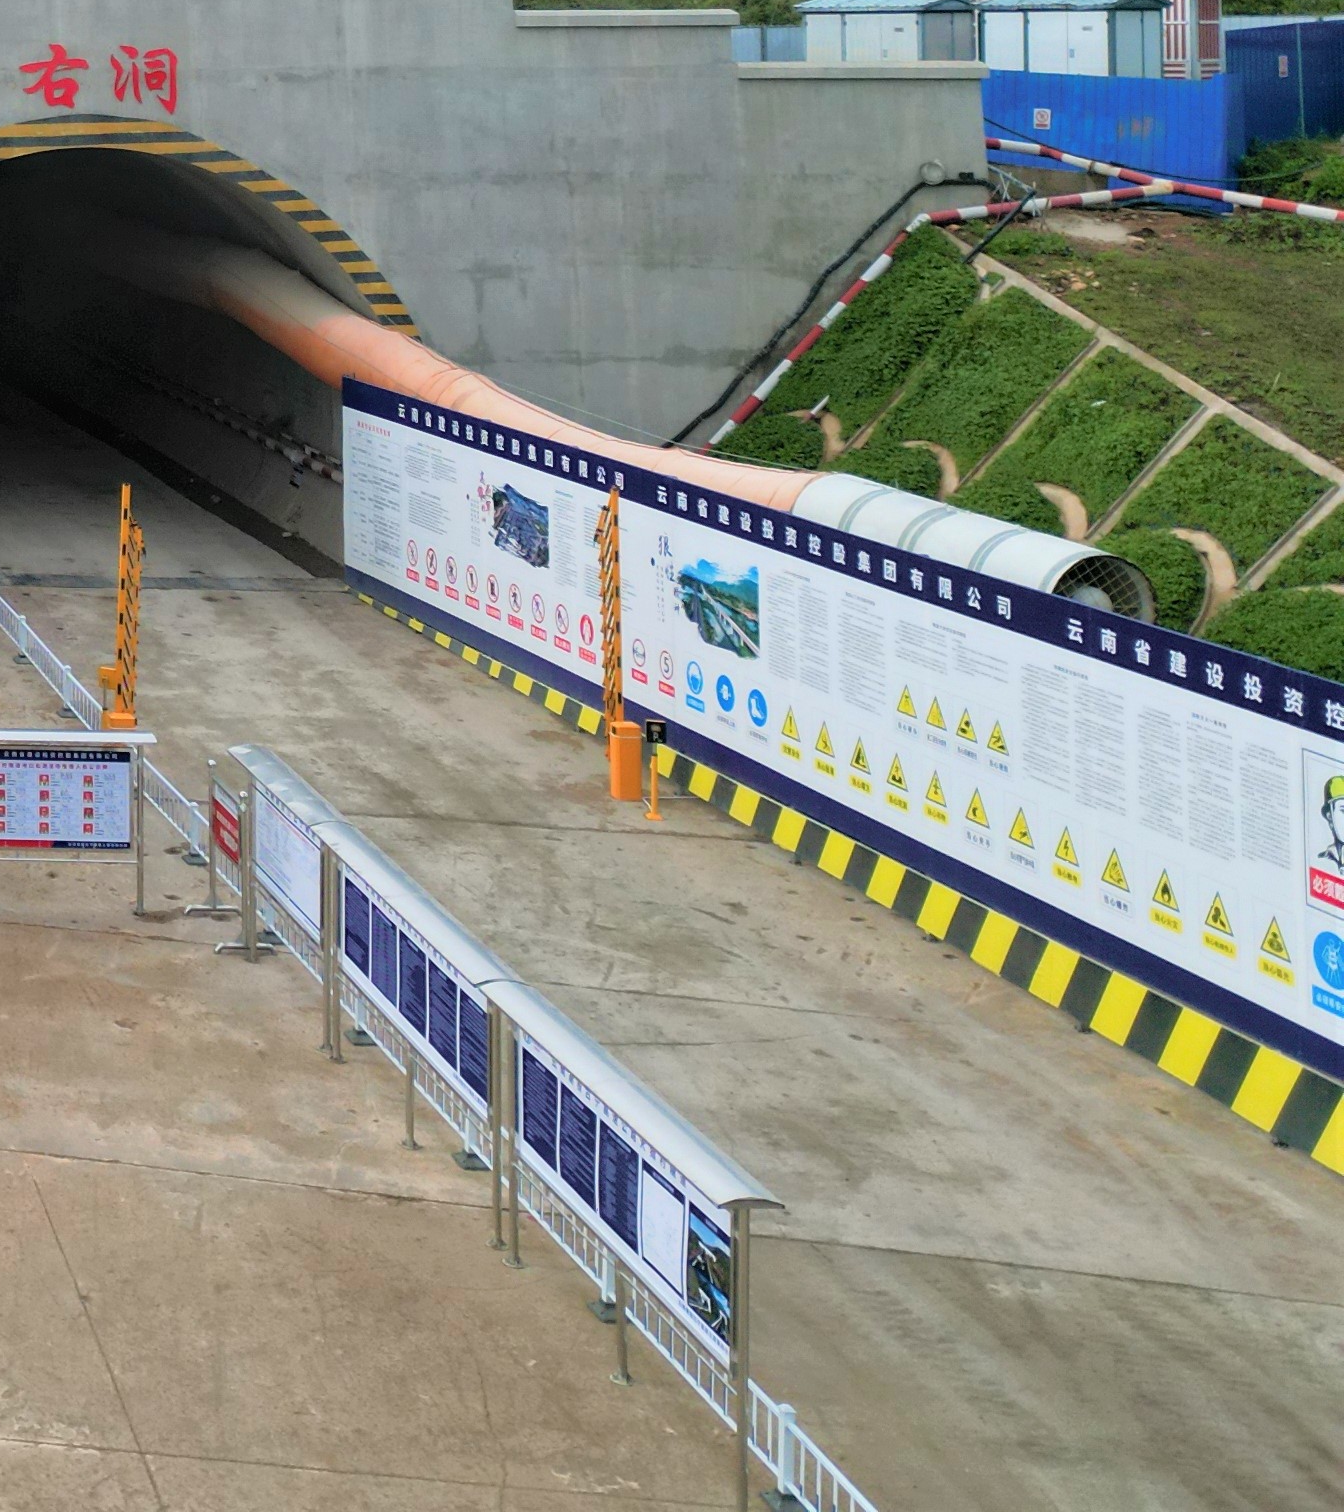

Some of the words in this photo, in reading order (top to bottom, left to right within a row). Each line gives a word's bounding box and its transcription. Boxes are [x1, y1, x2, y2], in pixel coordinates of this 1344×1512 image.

[19, 43, 178, 115] 右洞
[398, 402, 625, 491] 云南省建设投资控股集团有限公司
[657, 485, 1012, 620] 云南省建设投资控股集团有限公司
[663, 655, 670, 674] 5
[1067, 617, 1344, 731] 云南省建设投资控
